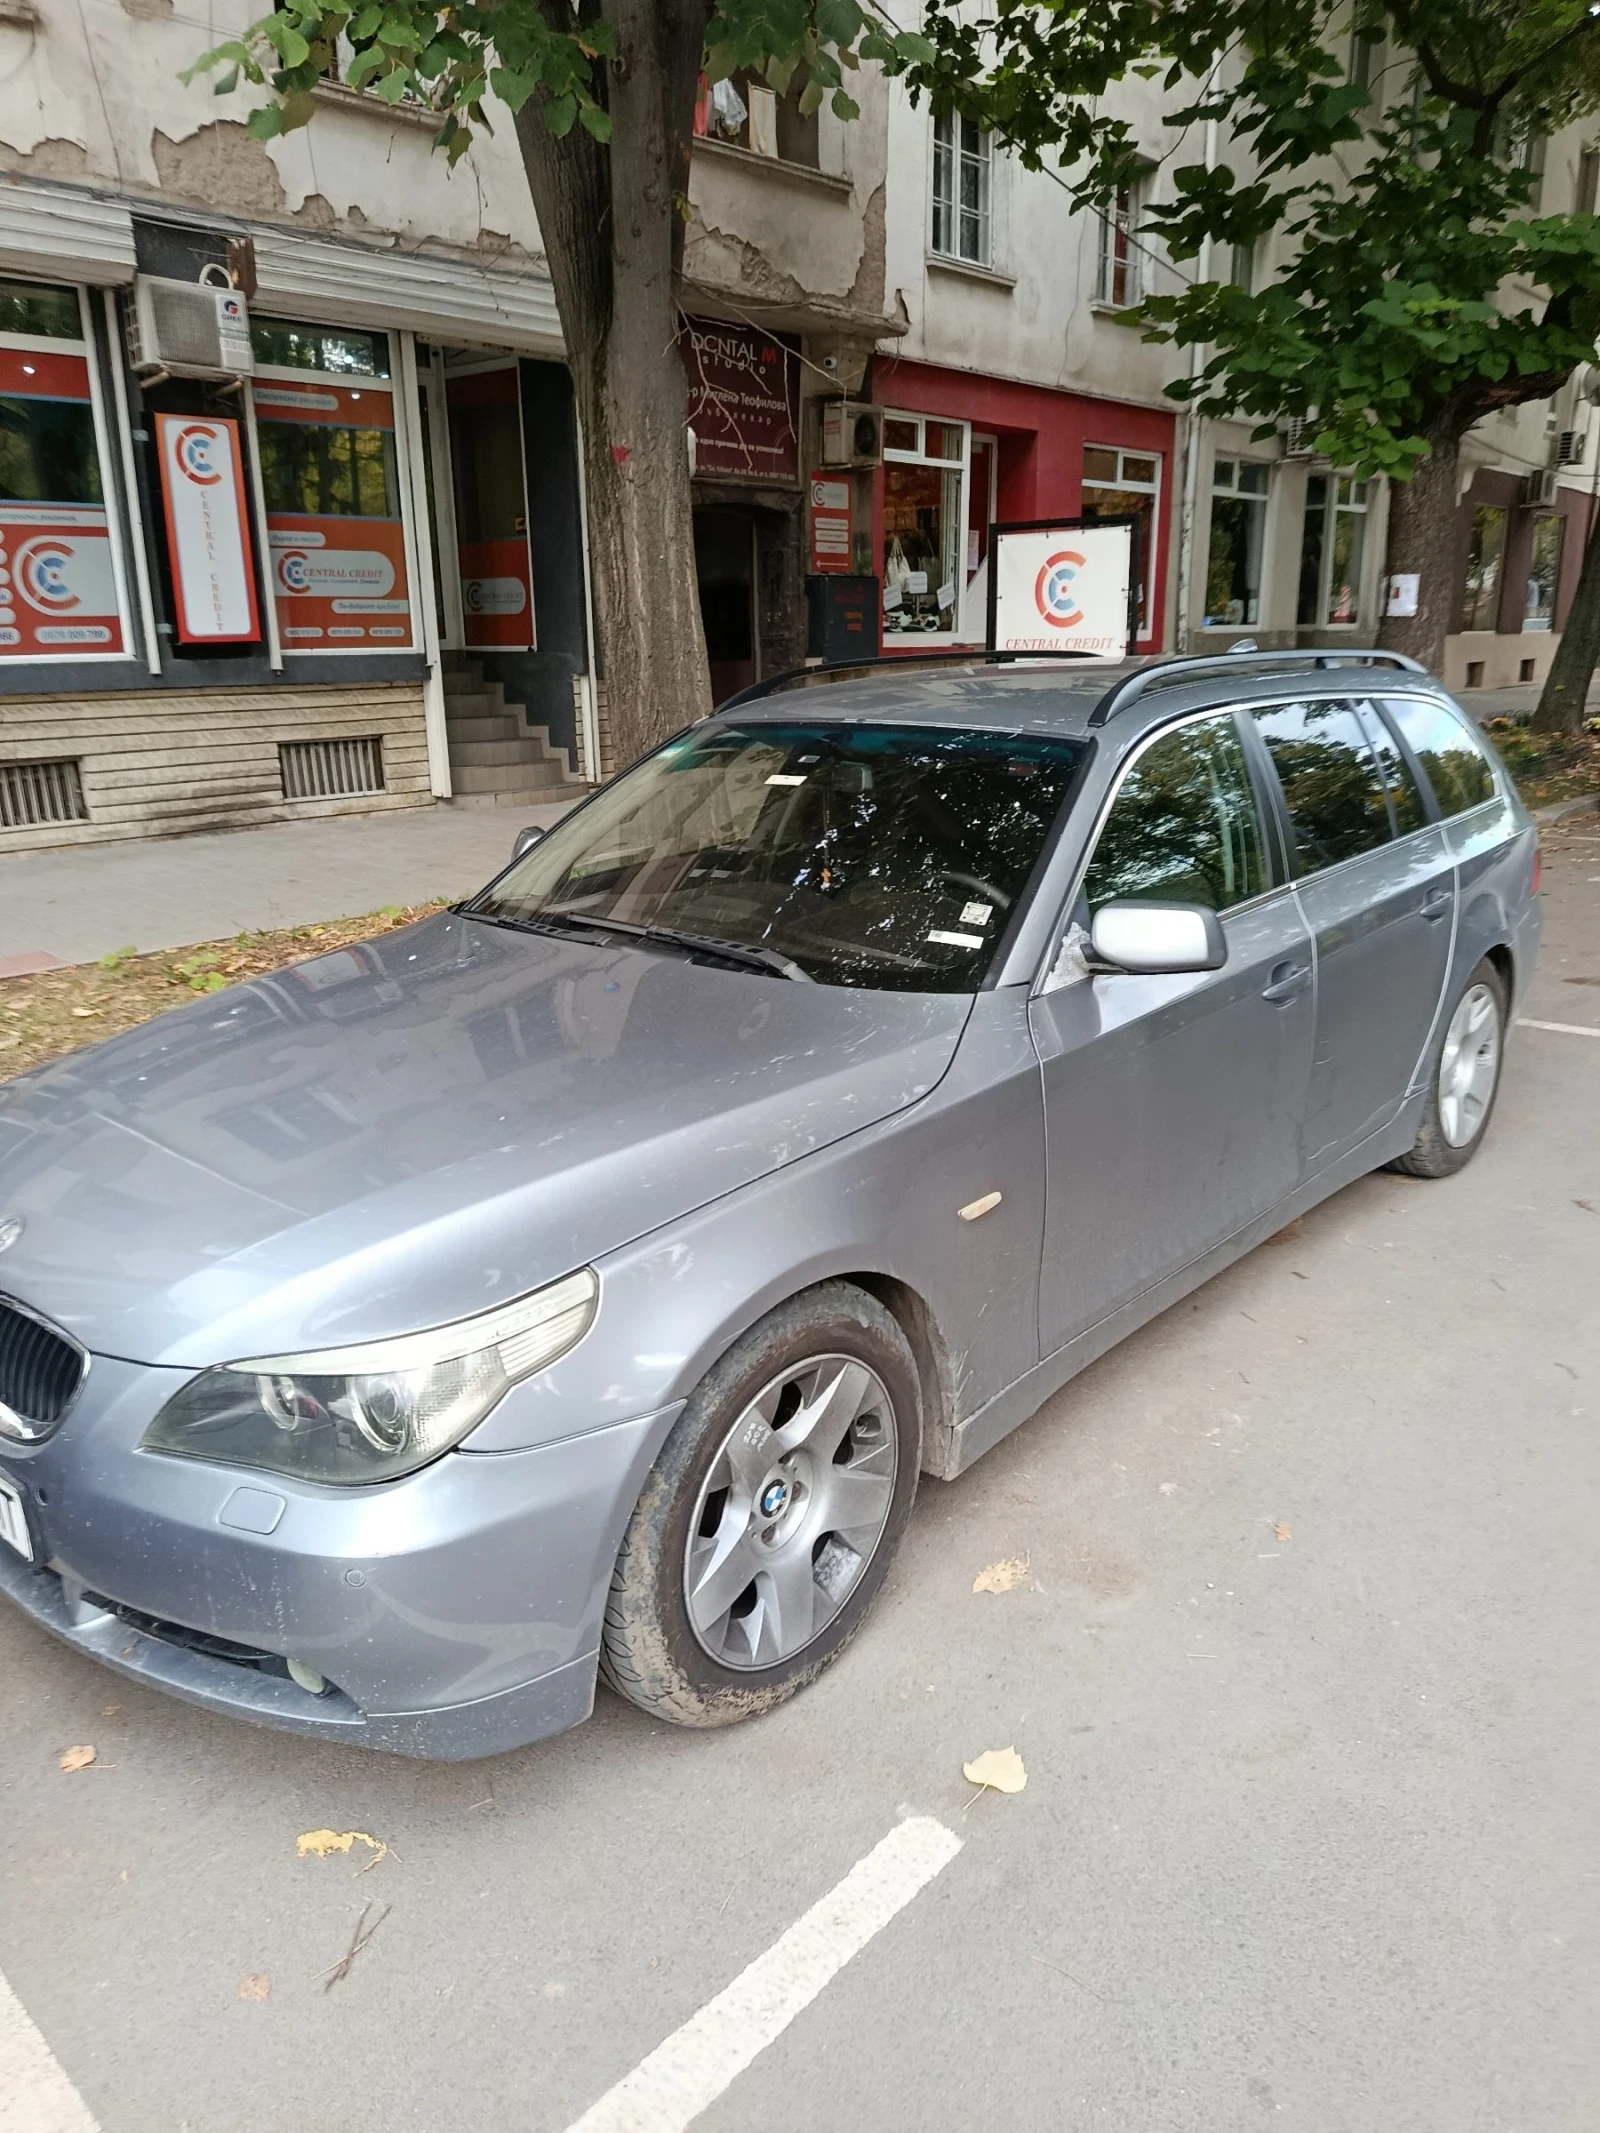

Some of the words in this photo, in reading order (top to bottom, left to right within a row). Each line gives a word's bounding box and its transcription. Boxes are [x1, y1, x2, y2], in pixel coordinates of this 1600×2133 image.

[303, 568, 346, 578] CENTRAL
[348, 569, 384, 578] CREDIT
[1005, 638, 1062, 651] CENTRAL
[1065, 637, 1116, 650] CREDIT
